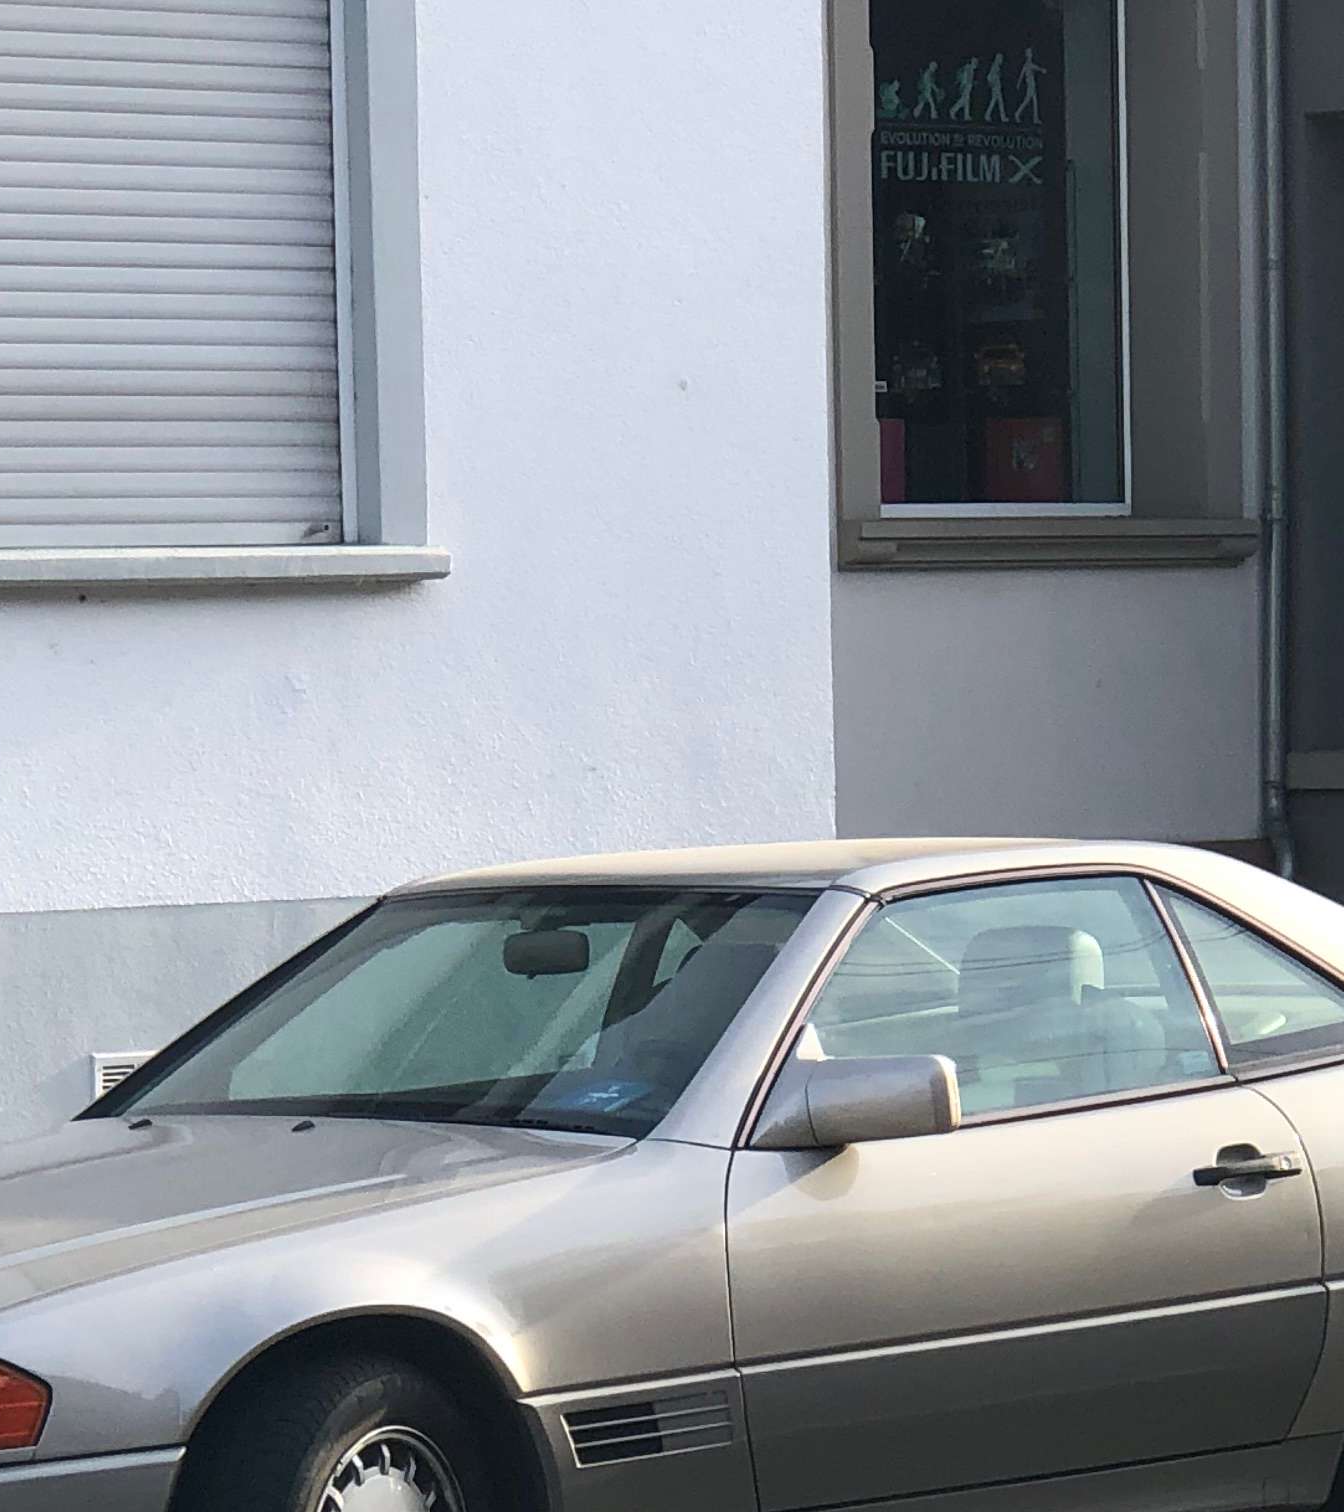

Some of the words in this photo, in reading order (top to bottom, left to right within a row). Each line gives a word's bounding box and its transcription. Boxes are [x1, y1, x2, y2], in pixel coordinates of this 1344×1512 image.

[880, 130, 951, 146] EVOLUTION
[967, 133, 1044, 150] REVOLUTION
[880, 150, 1002, 184] FUJIFILM
